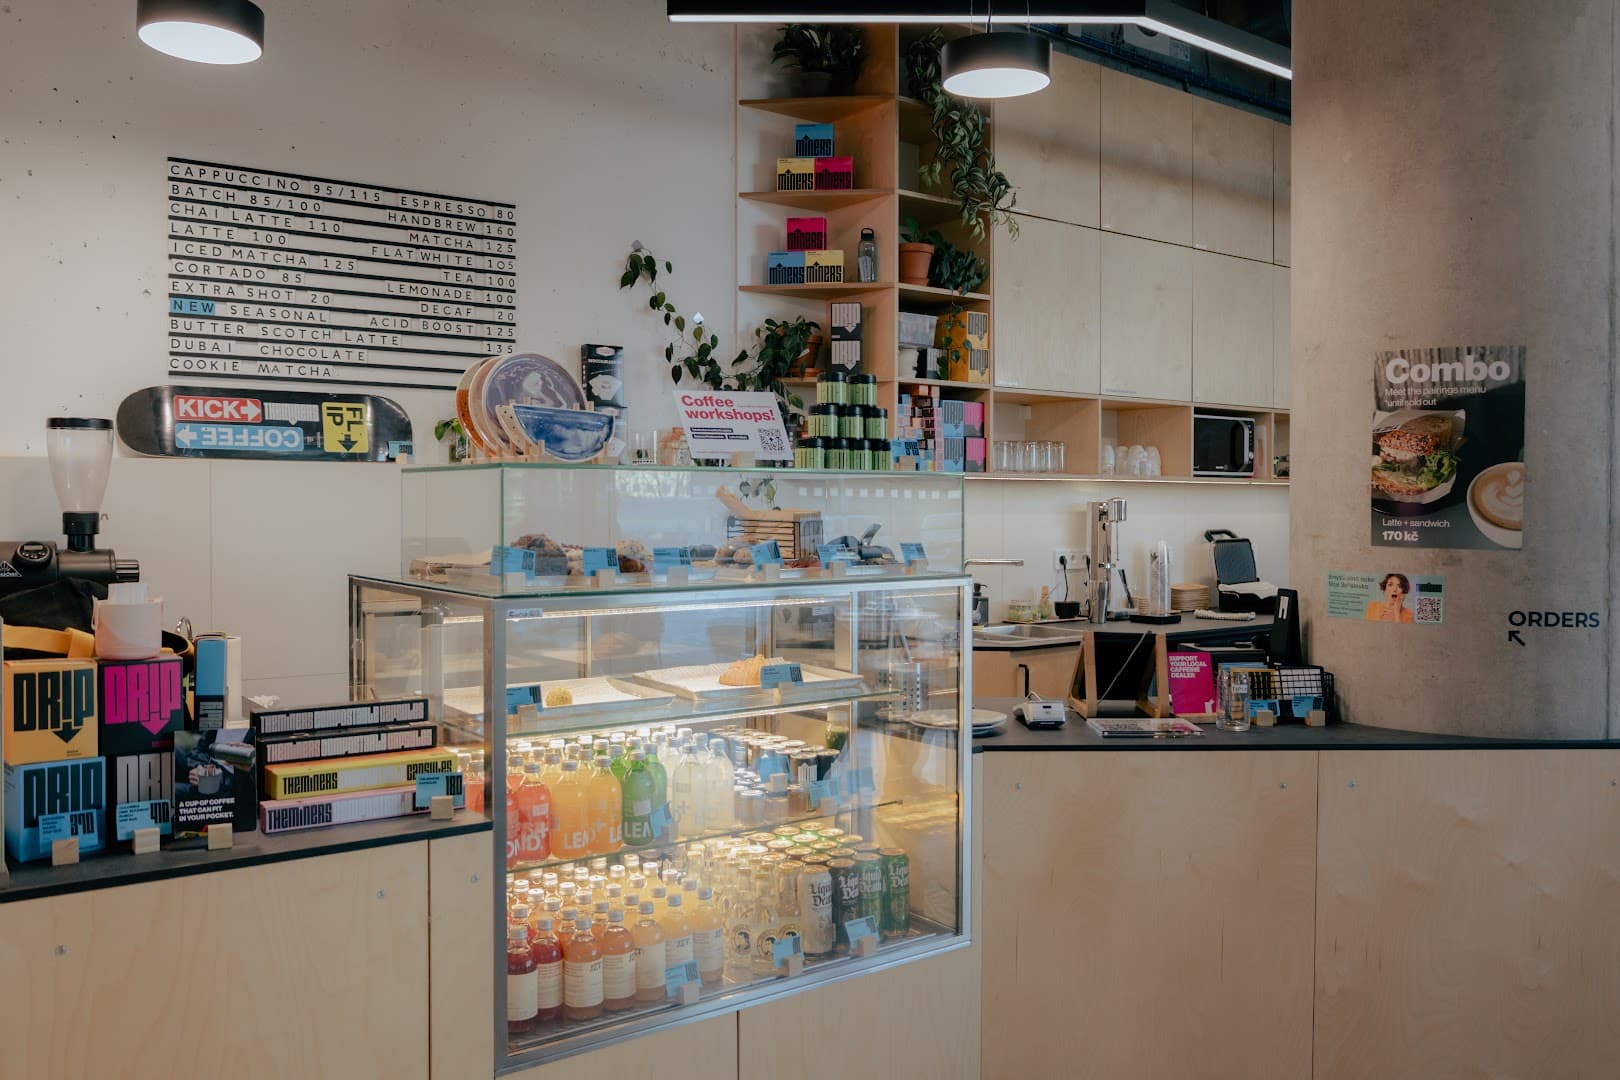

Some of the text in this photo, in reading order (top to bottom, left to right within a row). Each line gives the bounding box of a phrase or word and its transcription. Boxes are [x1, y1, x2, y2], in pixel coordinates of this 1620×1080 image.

[170, 165, 380, 202] CAPPUCCINO 95/115
[171, 184, 321, 212] BATCH 85/100
[401, 196, 514, 219] ESPRESSO 80
[170, 203, 341, 233] CHAI LATTE 110
[171, 223, 286, 245] LATTE 100
[486, 225, 514, 237] 160
[409, 233, 513, 253] MATCHA 125
[174, 243, 355, 271] ICED MATCHA 125
[488, 259, 514, 270] 105
[174, 263, 302, 284] CORTADO 85
[443, 272, 515, 287] TEA 100
[172, 281, 330, 305] EXTRA SHOT 20
[387, 283, 513, 304] LEMONADE 100
[173, 300, 327, 322] NEW SEASONAL
[420, 304, 514, 321] DECAF 20
[171, 319, 399, 346] BUTTER SCOTCH LATTE
[370, 318, 513, 337] ACID BOOST 125
[171, 338, 366, 361] DUBAI CHOCOLATE
[487, 344, 513, 354] 135
[170, 358, 331, 377] COOKIE MATCHA
[1385, 355, 1511, 384] Combo
[681, 394, 734, 408] Coffee
[1385, 387, 1406, 396] Meet
[1408, 387, 1422, 396] the
[1460, 386, 1487, 394] menu
[178, 398, 241, 420] KICK
[685, 408, 776, 423] workshops!
[202, 426, 300, 448] COFFEE
[1382, 518, 1402, 527] Latte
[1409, 519, 1450, 528] sandwich
[1382, 531, 1402, 541] 170
[1508, 610, 1600, 628] ORDERS
[446, 775, 462, 796] 180
[187, 813, 206, 821] YOUR
